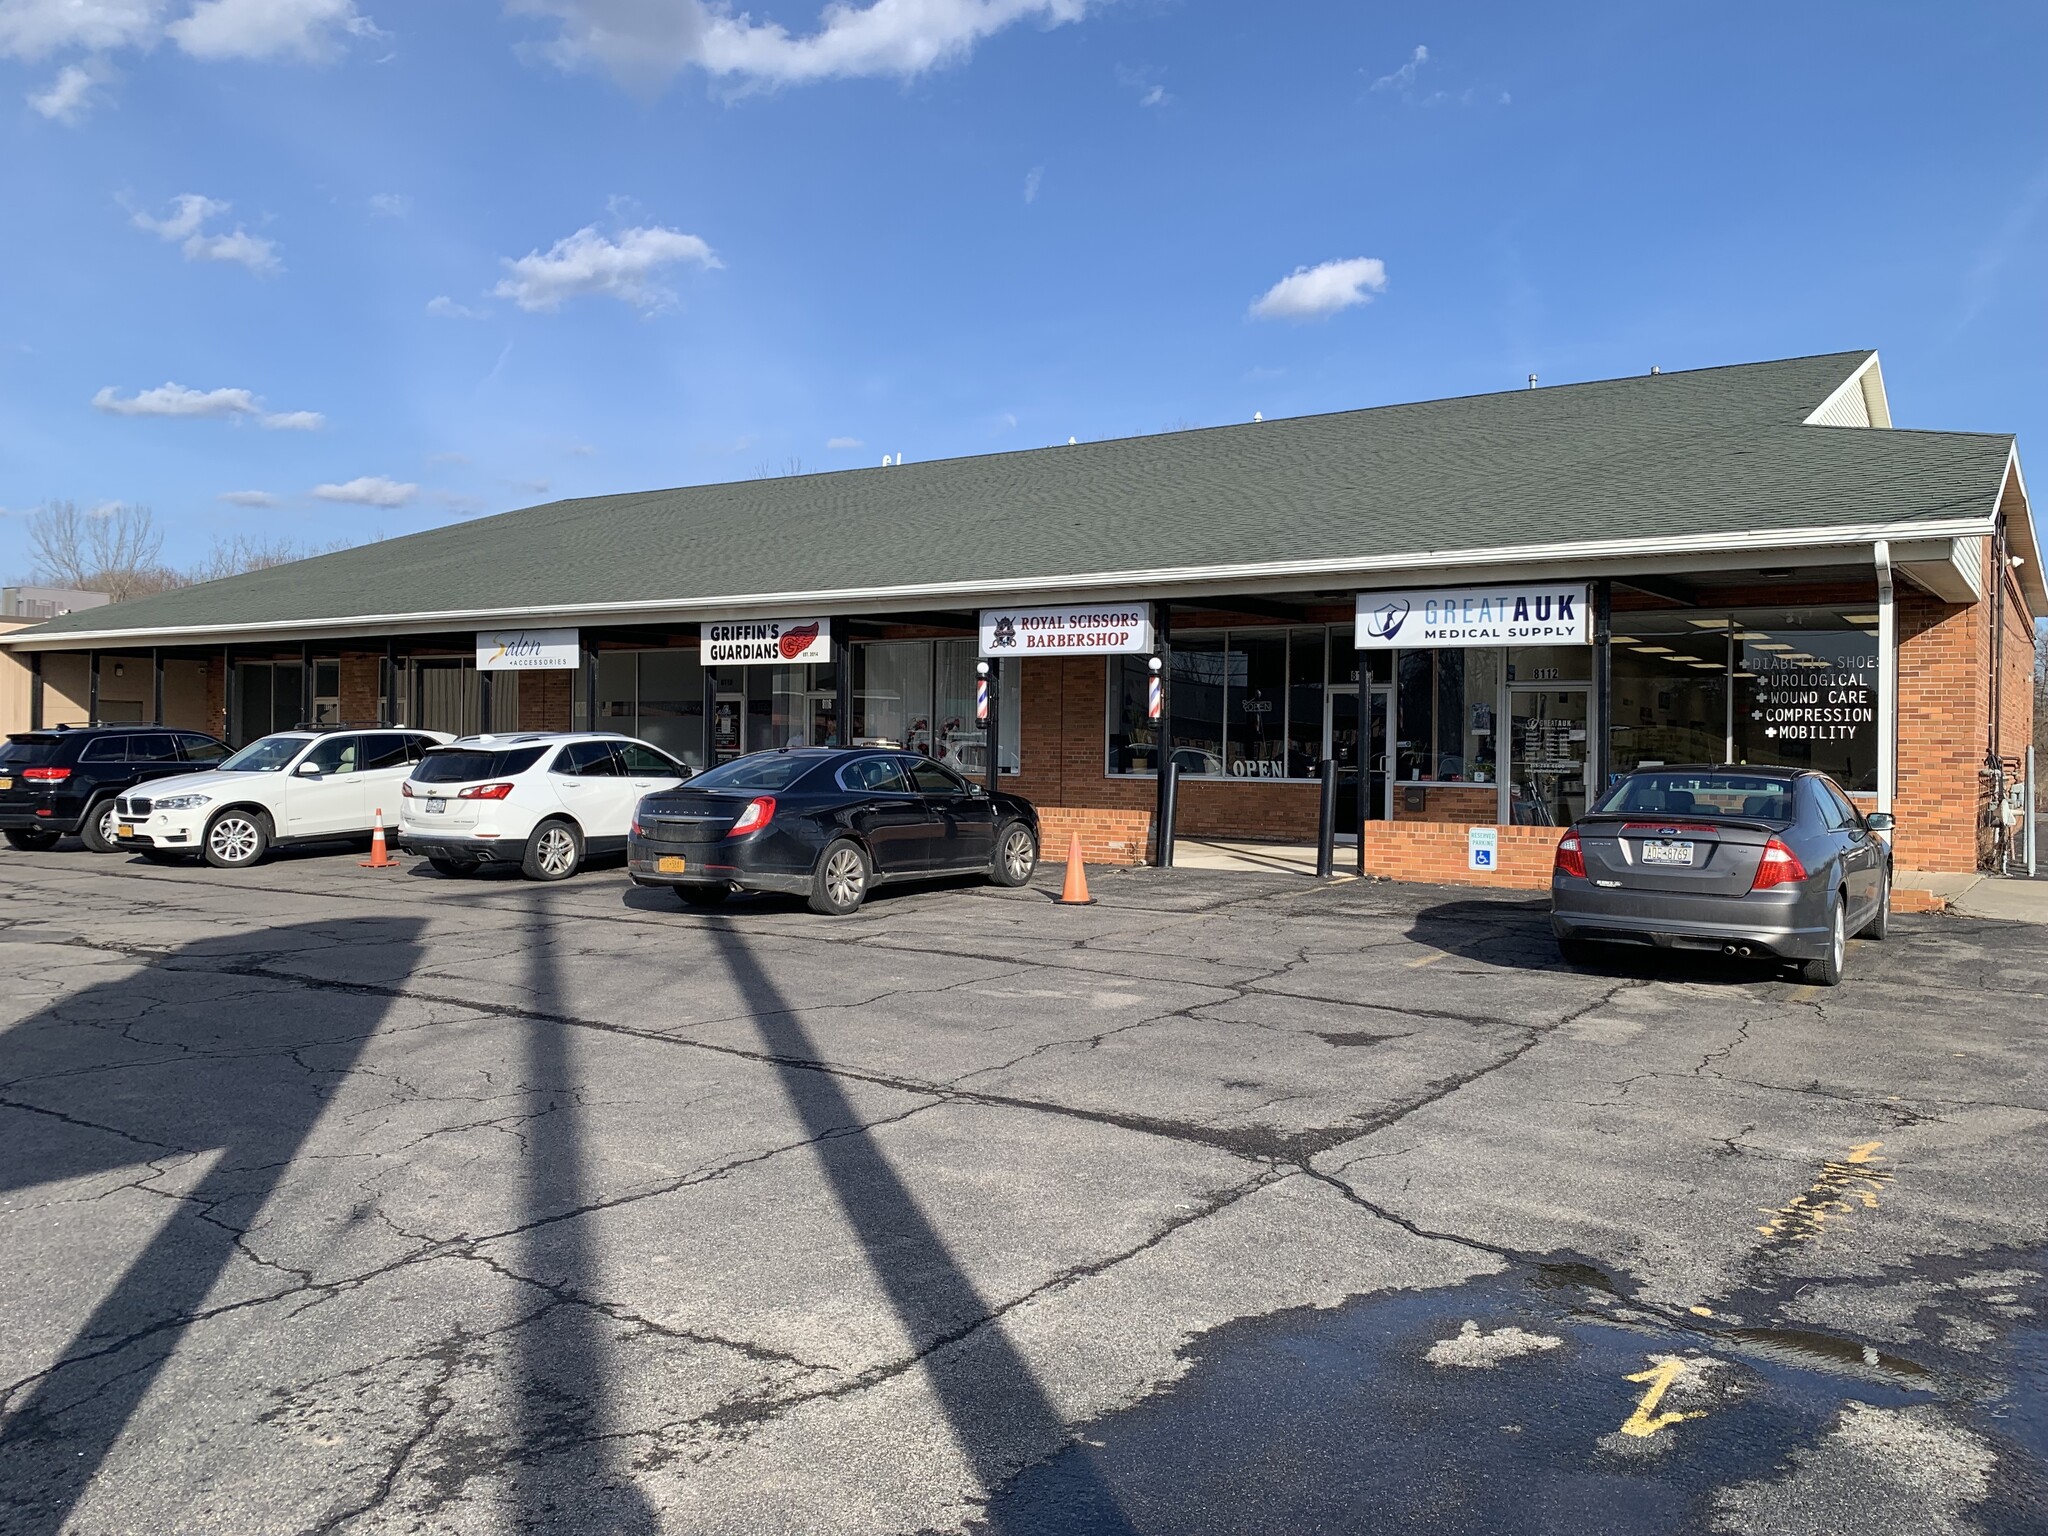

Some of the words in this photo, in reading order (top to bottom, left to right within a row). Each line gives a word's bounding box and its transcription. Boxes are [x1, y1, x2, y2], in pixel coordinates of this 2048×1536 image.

[1021, 616, 1065, 631] ROYAL
[1069, 613, 1139, 629] SCISSORS
[710, 624, 779, 642] GRIFFIN'S
[1425, 628, 1501, 639] MEDICAL
[1508, 626, 1575, 638] SUPPLY
[1027, 632, 1129, 648] BARBERSHOP
[488, 631, 541, 665] Salon
[710, 643, 779, 660] GUARDIANS
[513, 658, 567, 666] ACCESSORIES
[1752, 657, 1826, 670] DIABETIC
[1533, 668, 1559, 679] 8112
[1771, 673, 1868, 687] UROLOGICAL
[1770, 691, 1818, 704] WOUND
[1828, 690, 1868, 704] CARE
[1247, 702, 1271, 711] OPEN
[1766, 708, 1872, 722] COMPRESSION
[1779, 725, 1856, 740] MOBILITY
[1232, 760, 1283, 778] OPEN
